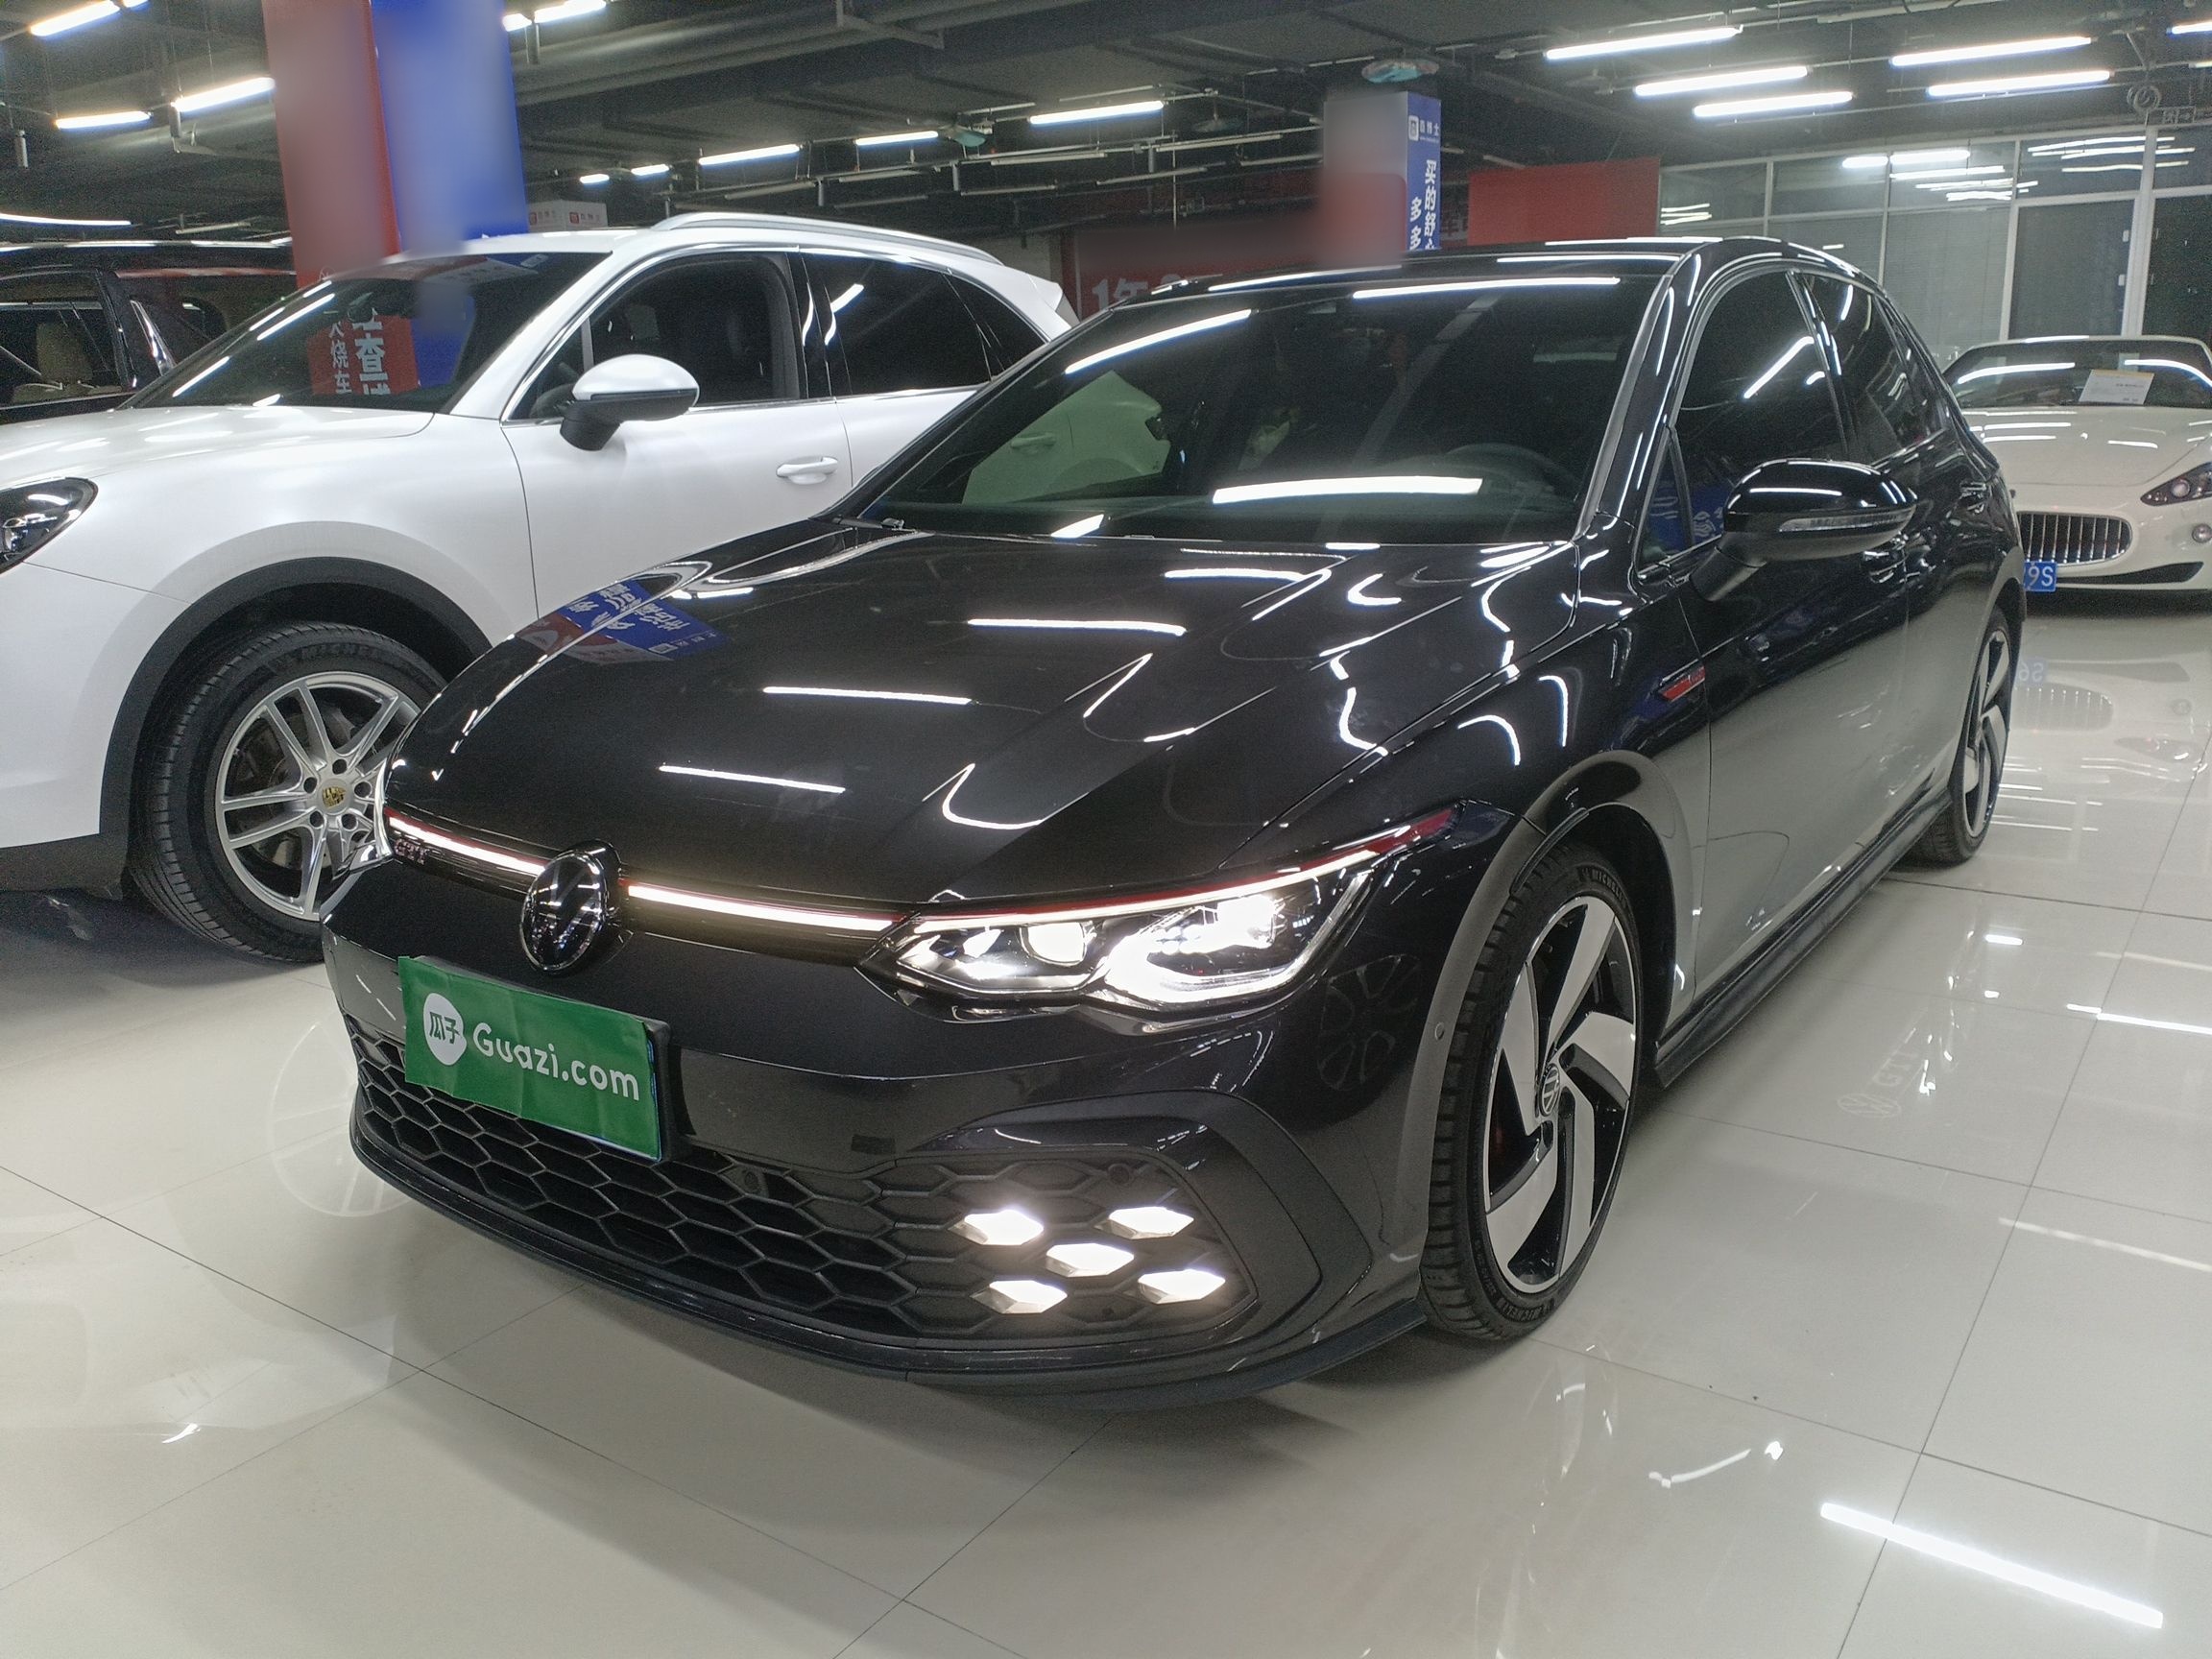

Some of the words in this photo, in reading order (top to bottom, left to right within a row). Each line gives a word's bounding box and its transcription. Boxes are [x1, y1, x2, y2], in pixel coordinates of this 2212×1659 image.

[2024, 565, 2054, 587] 9S
[429, 1011, 461, 1045] 瓜子
[472, 1022, 639, 1101] Guazi.com
